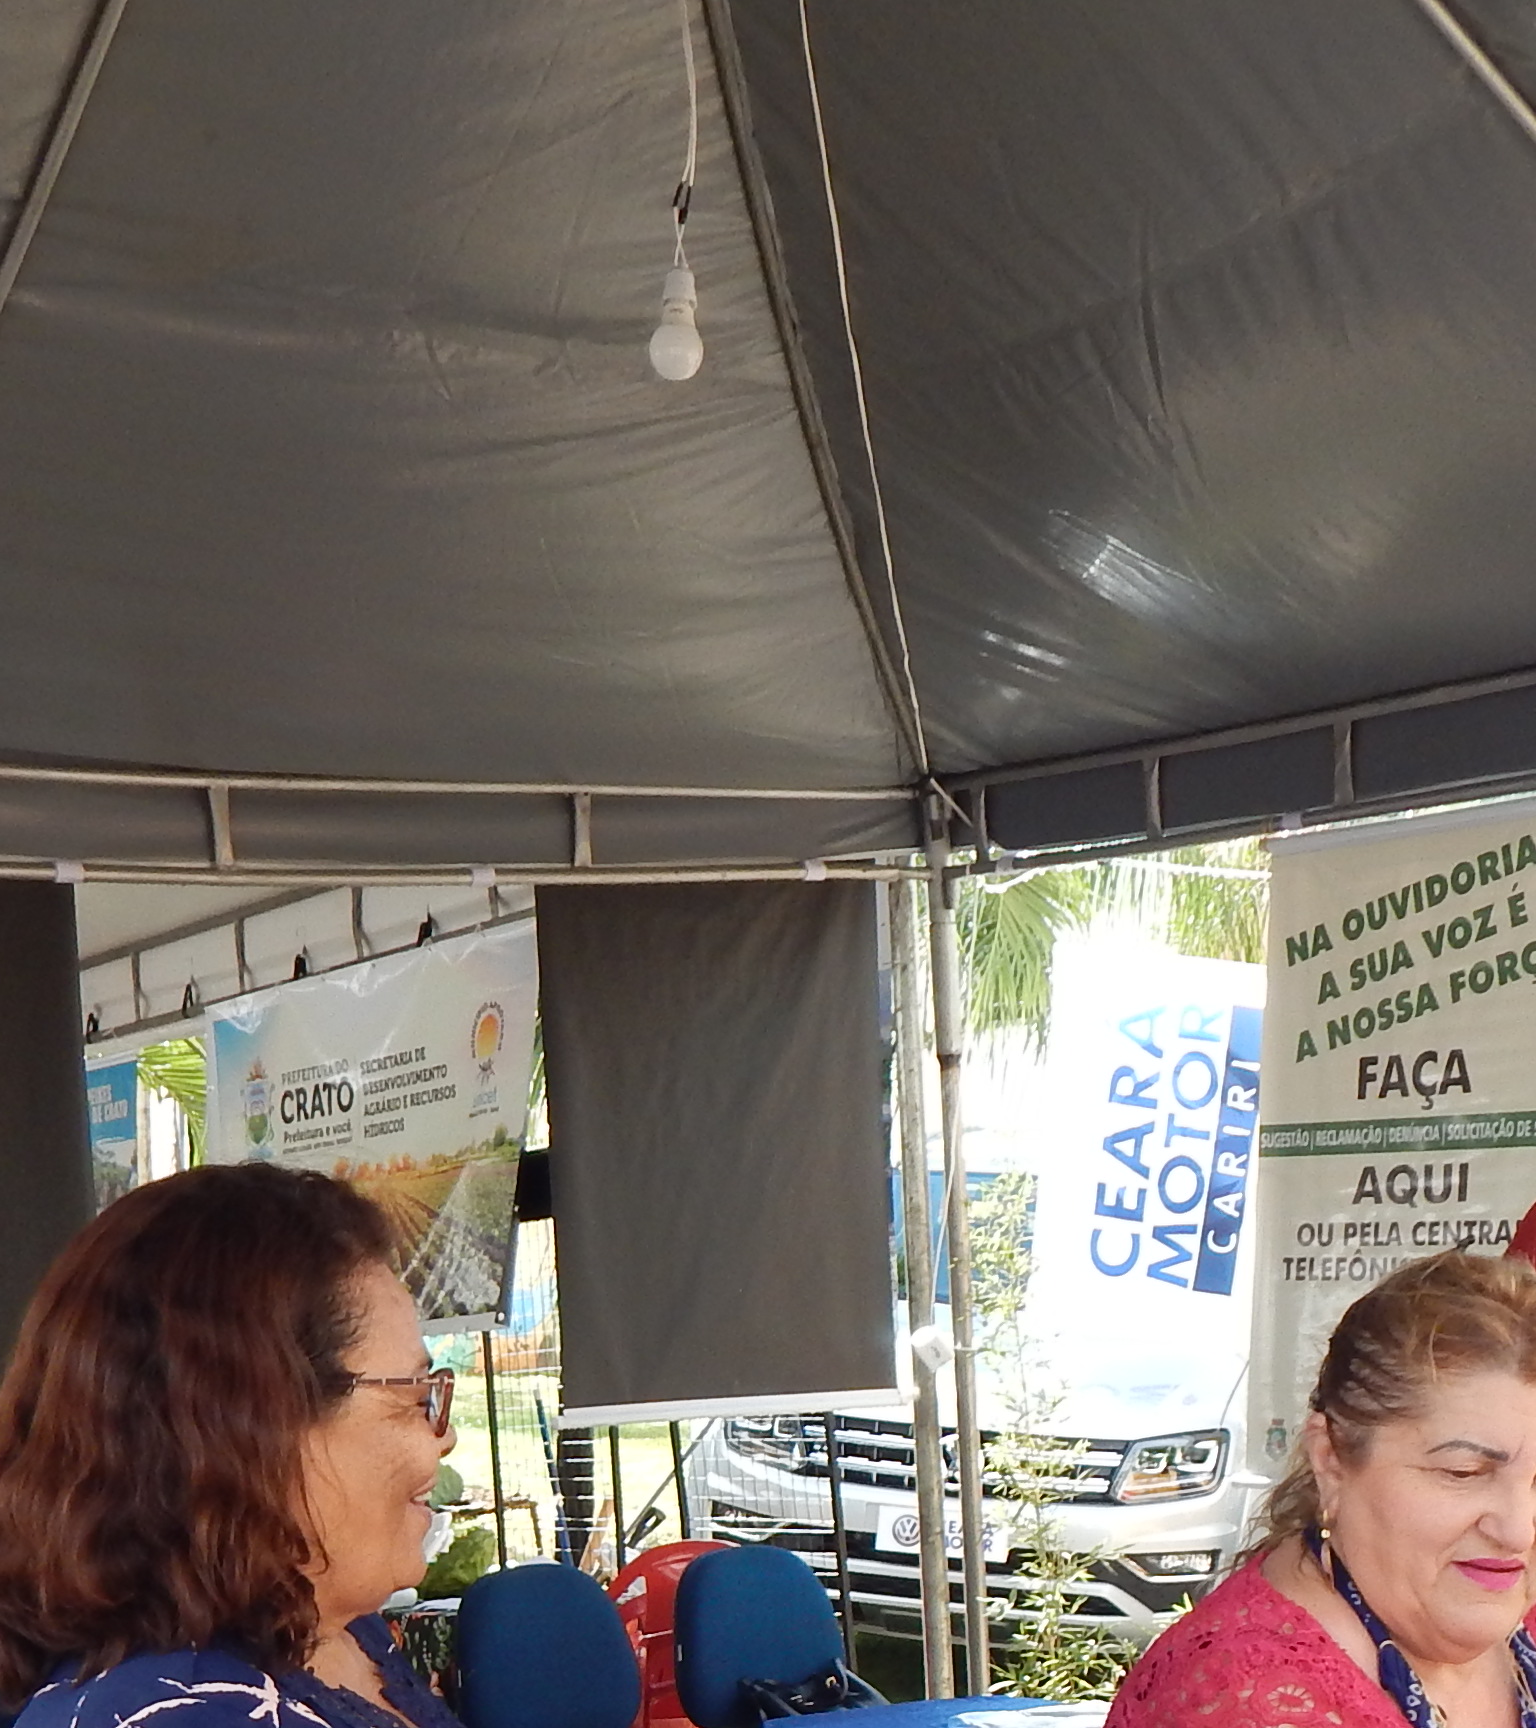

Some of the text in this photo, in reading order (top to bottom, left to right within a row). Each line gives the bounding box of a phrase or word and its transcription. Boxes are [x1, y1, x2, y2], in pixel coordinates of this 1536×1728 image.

[1285, 923, 1333, 967] NA
[1317, 882, 1529, 1005] A SUA VOZ É
[1296, 1030, 1318, 1063] A
[1326, 982, 1440, 1050] NOSSA
[1357, 1048, 1472, 1110] FAÇA
[280, 1080, 354, 1124] CRATO
[1146, 1004, 1224, 1288] MOTOR
[1207, 1060, 1261, 1254] CARIRI
[1261, 1127, 1309, 1149] SUGESTÃO
[1315, 1125, 1382, 1148] RECLAMAÇÃO
[1389, 1122, 1440, 1143] DENÚNCIA
[1517, 1121, 1533, 1137] DE
[1352, 1163, 1469, 1208] AQUI
[1297, 1223, 1333, 1246] OU
[1344, 1221, 1402, 1246] PELA
[1283, 1249, 1410, 1281] TELEFÔNI
